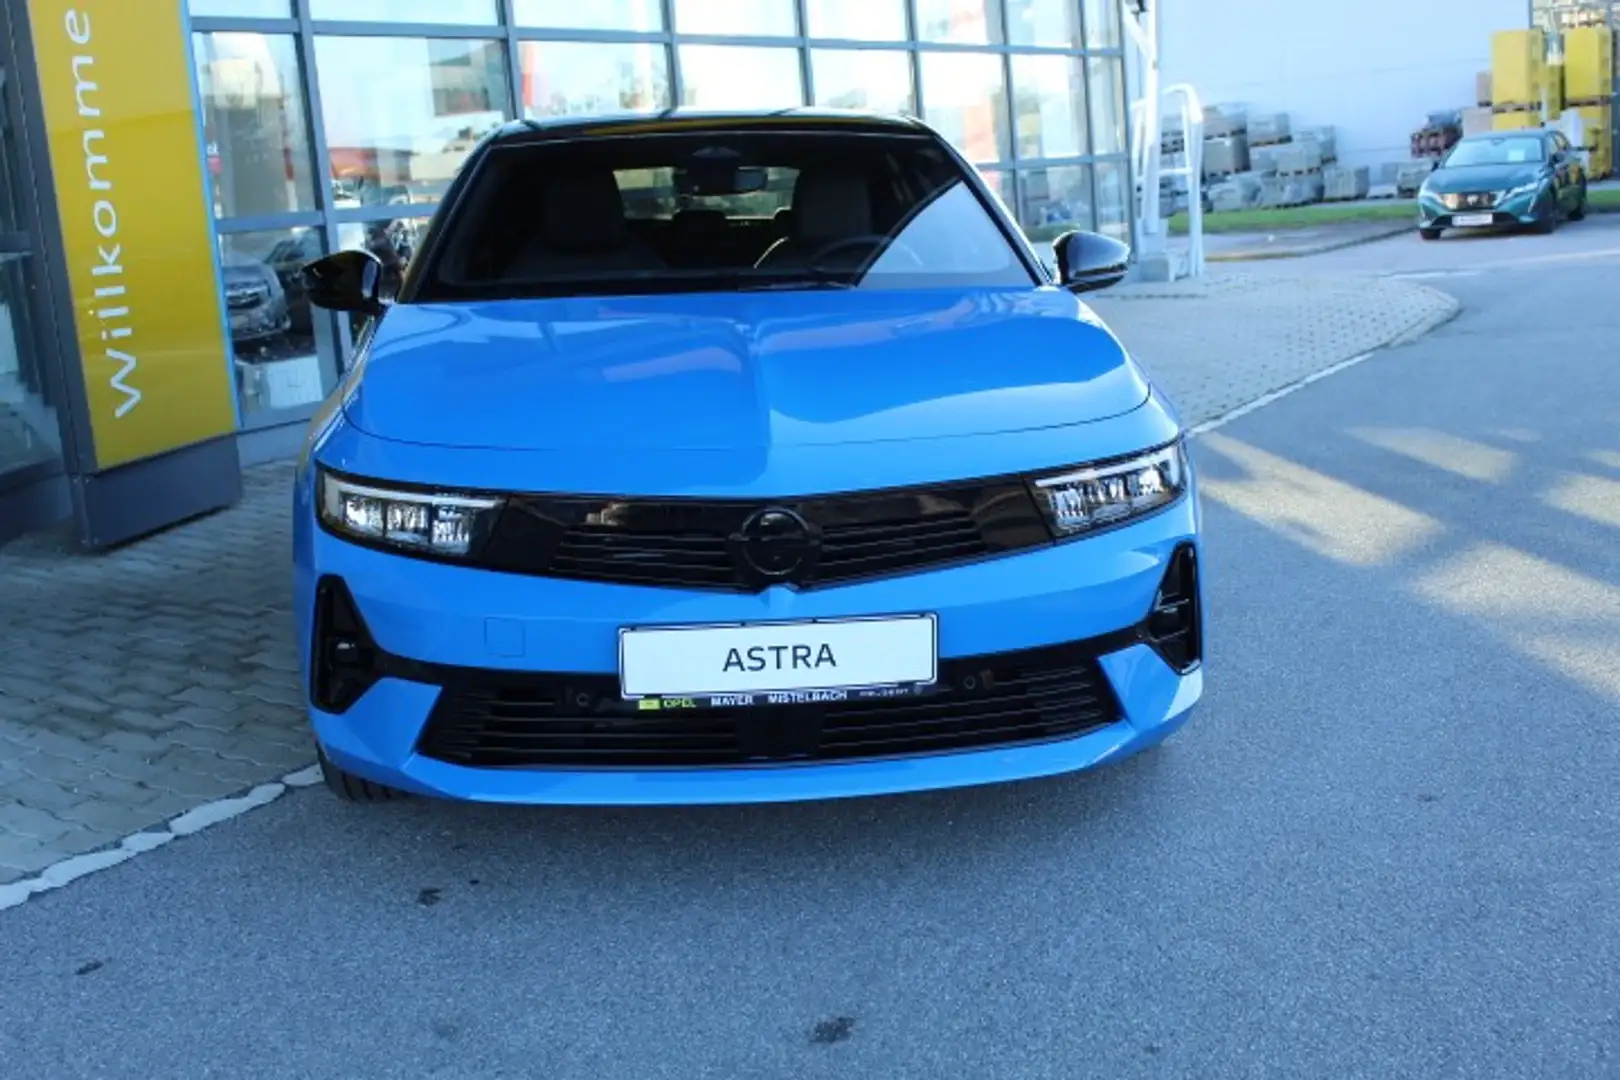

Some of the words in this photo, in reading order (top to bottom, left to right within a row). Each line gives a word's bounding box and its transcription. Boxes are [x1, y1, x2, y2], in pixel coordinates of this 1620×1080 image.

[722, 642, 837, 673] ASTRA
[663, 696, 697, 709] OPEL
[710, 694, 754, 708] MAYER
[767, 689, 848, 704] MISTELBACH
